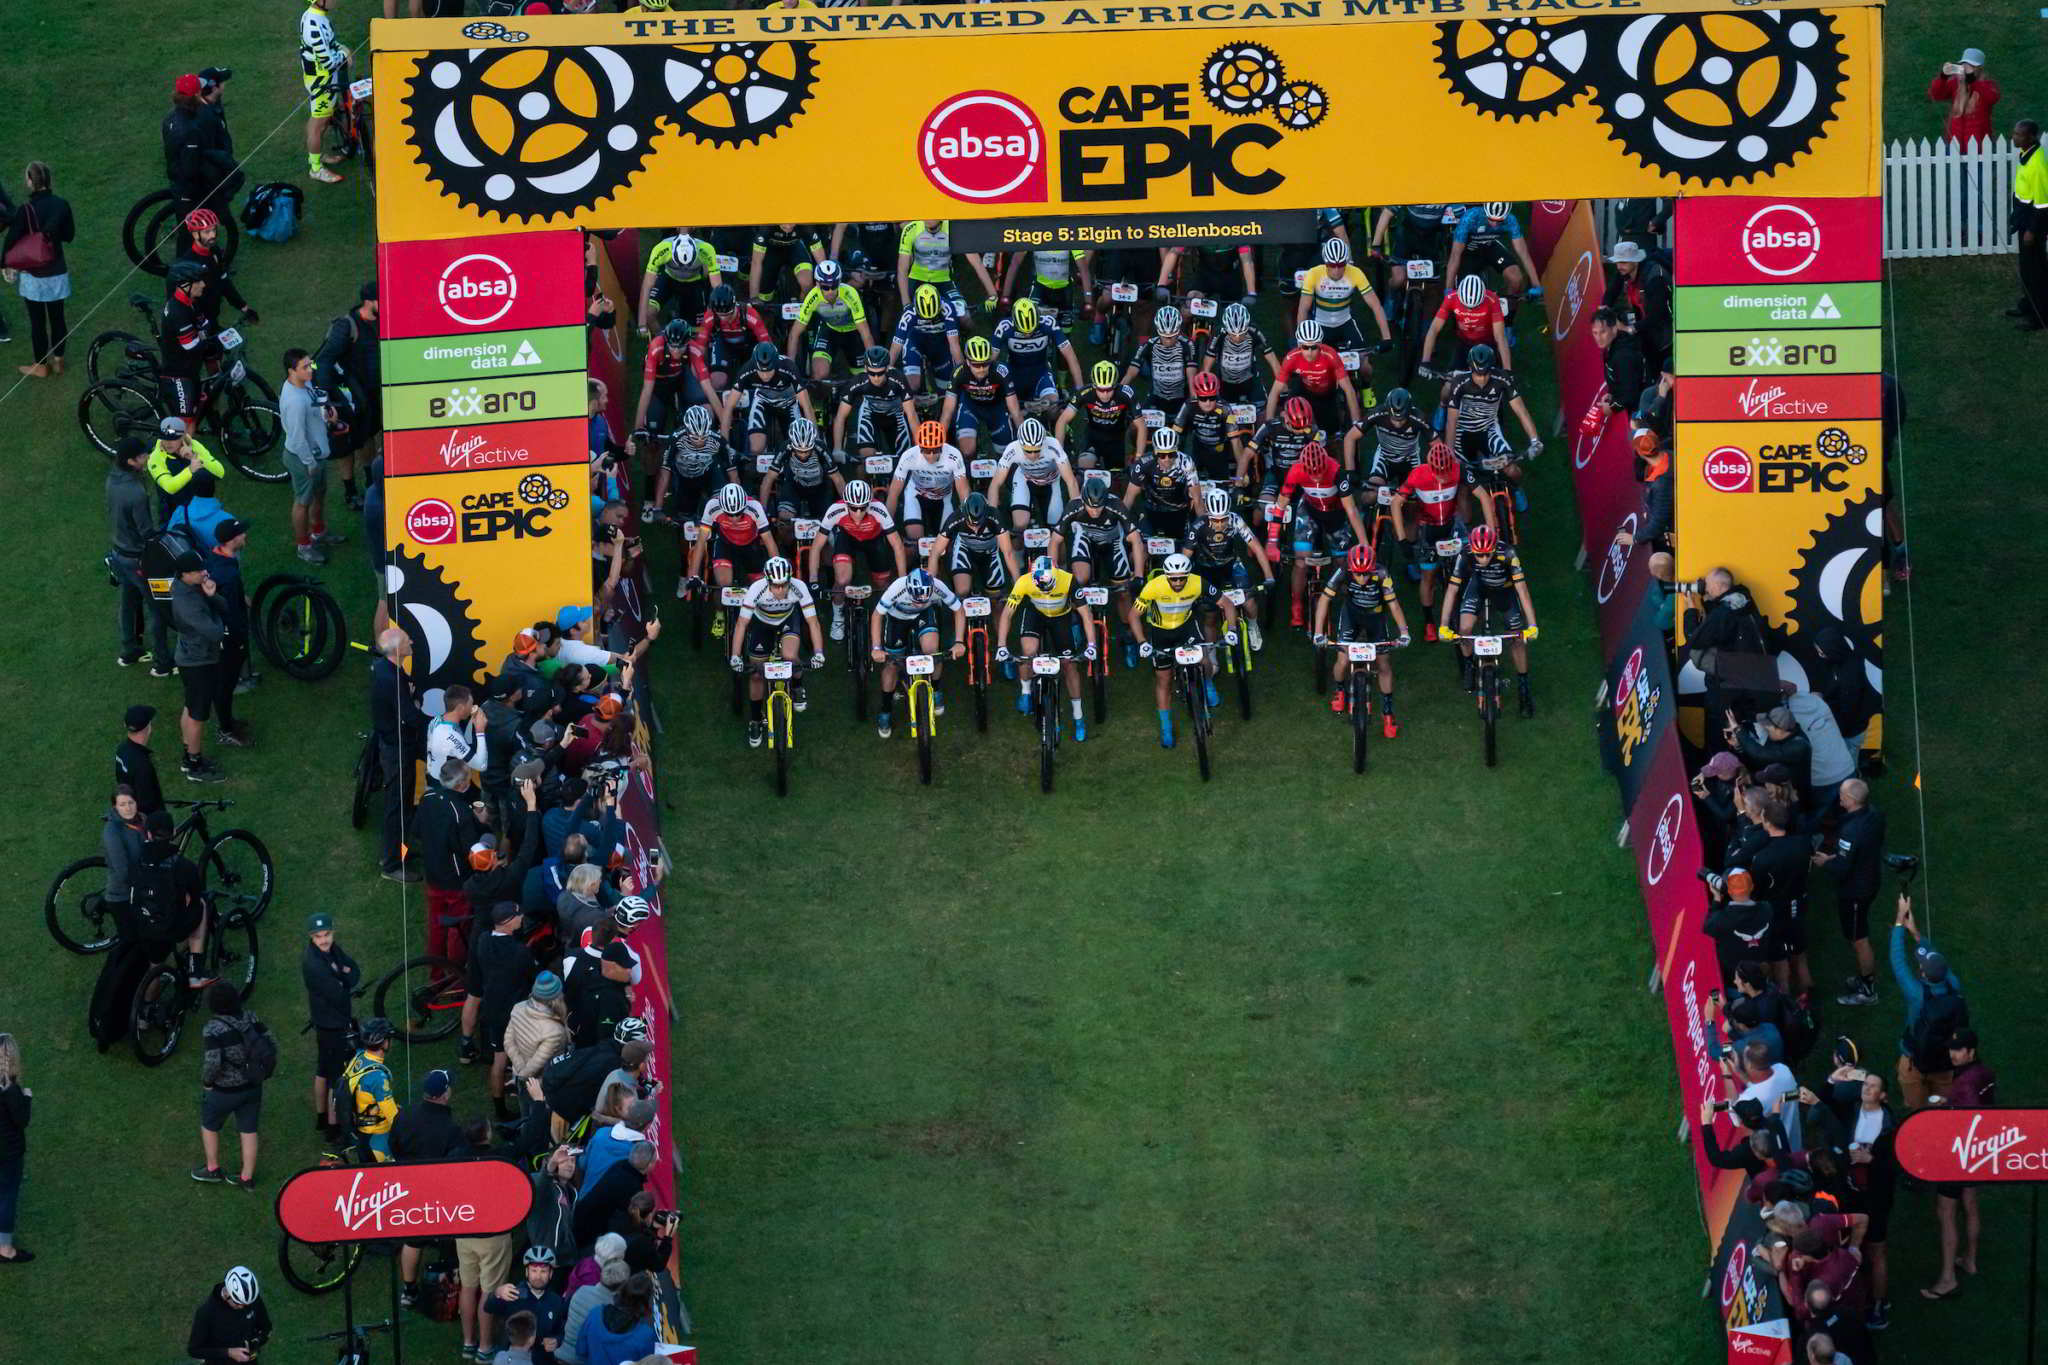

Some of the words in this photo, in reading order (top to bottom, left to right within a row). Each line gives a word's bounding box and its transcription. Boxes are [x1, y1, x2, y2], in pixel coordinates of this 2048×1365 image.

[624, 18, 735, 37] THE
[757, 10, 1045, 34] UNTAMED
[1061, 1, 1322, 25] AFRICAN
[1344, 0, 1465, 16] MTB
[1059, 83, 1189, 124] CAPE
[938, 126, 1026, 159] absa
[1060, 123, 1286, 202] EPIC
[1003, 229, 1053, 245] Stage
[1058, 228, 1074, 241] 5:
[1078, 226, 1122, 243] Elgin
[1127, 226, 1144, 239] to
[1149, 222, 1263, 239] Stellenbosch
[1752, 228, 1812, 249] absa
[447, 275, 509, 299] absa
[1723, 294, 1807, 309] dimension
[1771, 307, 1807, 320] data
[423, 344, 507, 360] dimension
[1013, 340, 1044, 350] DSV
[1730, 338, 1837, 367] exxaro
[471, 355, 507, 369] data
[430, 387, 536, 418] exxaro
[1738, 378, 1786, 417] Virgin
[1772, 399, 1829, 415] active
[440, 429, 487, 467] Virgin
[473, 448, 529, 465] active
[1759, 445, 1812, 460] CAPE
[1711, 461, 1746, 475] absa
[1759, 461, 1850, 493] EPIC
[461, 492, 514, 510] CAPE
[413, 514, 449, 528] absa
[461, 507, 552, 543] EPIC
[1683, 960, 1705, 1057] Conquer
[1698, 1051, 1709, 1087] as
[1951, 1114, 2027, 1175] Virgin
[2005, 1148, 2048, 1170] act
[335, 1171, 409, 1231] Virgin
[389, 1200, 476, 1226] active
